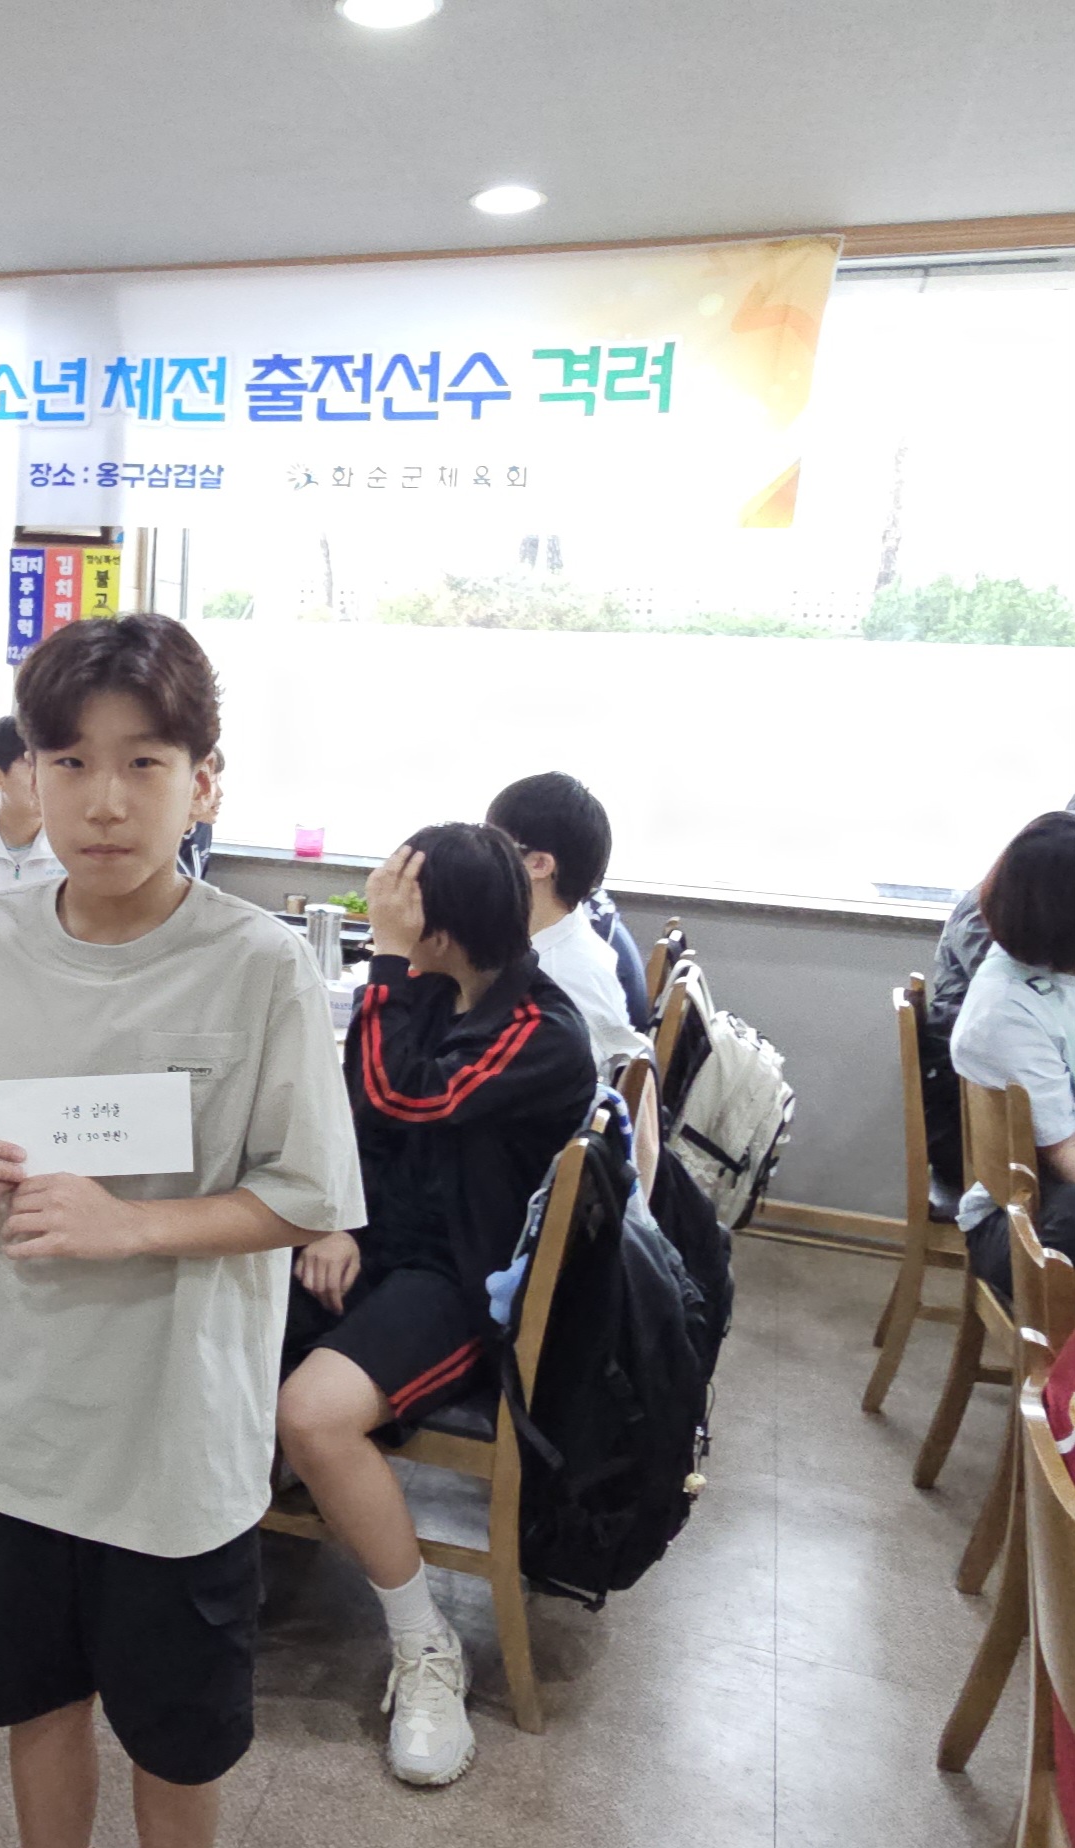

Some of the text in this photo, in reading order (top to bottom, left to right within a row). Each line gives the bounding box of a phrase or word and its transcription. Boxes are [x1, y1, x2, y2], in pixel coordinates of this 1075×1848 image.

[101, 355, 227, 422] 체전
[244, 350, 512, 422] 출전선수
[532, 342, 675, 415] 격려
[96, 462, 224, 489] 옹구삼겹살
[331, 465, 527, 489] 화순군체육회
[53, 555, 74, 633] 김치찌
[94, 569, 111, 619] 불고
[61, 1104, 81, 1119] 수영
